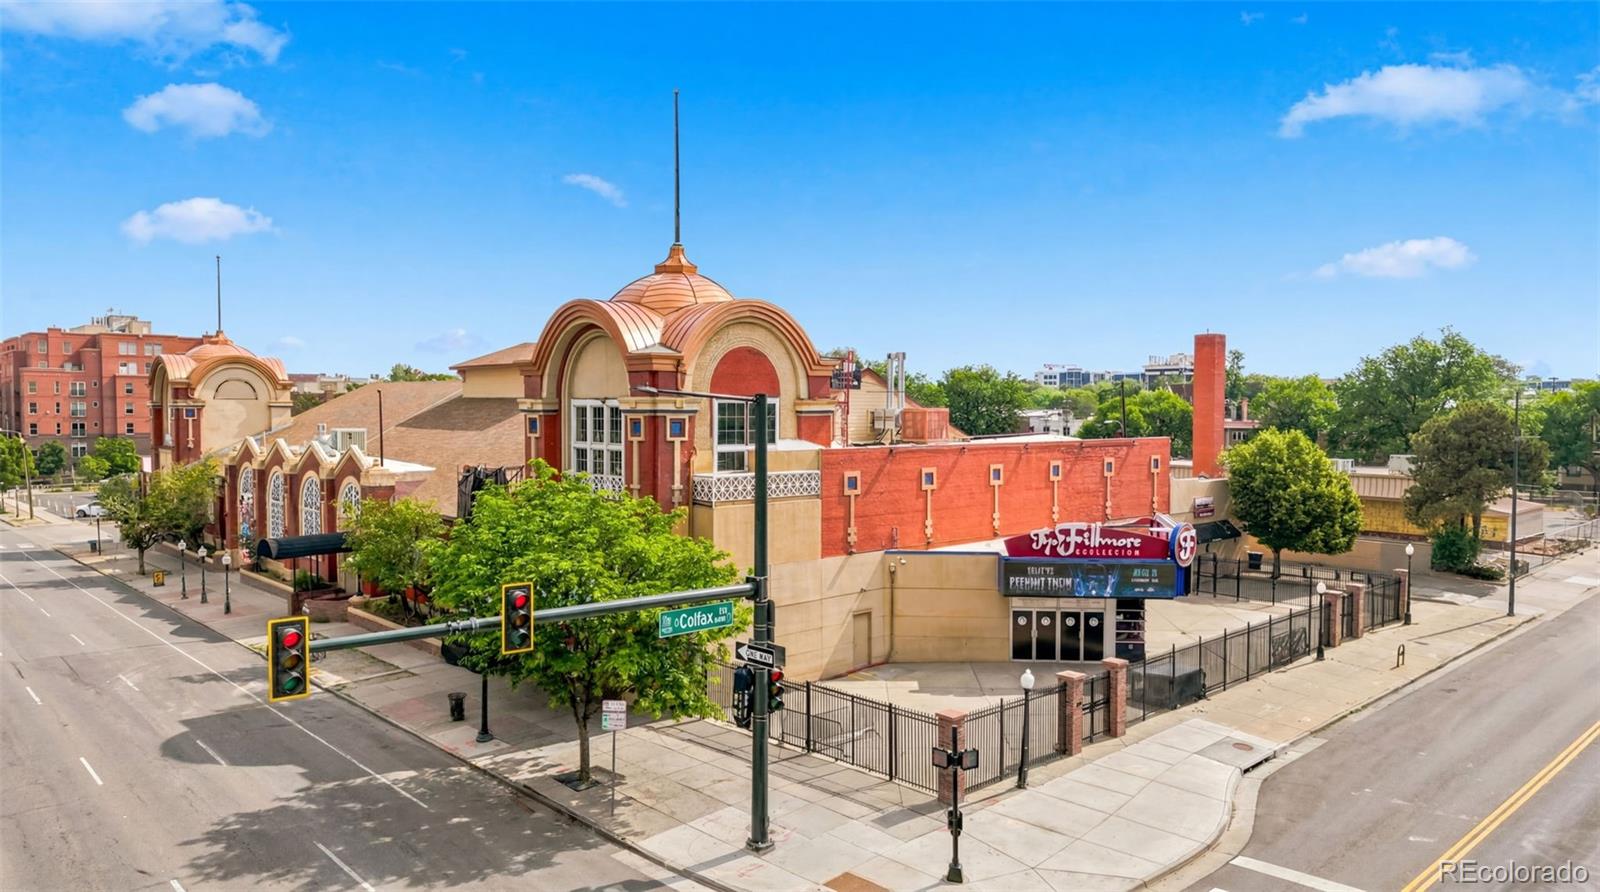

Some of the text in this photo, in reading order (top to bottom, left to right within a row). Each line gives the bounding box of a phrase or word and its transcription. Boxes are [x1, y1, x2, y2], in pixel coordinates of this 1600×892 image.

[1055, 522, 1141, 556] Fillmore
[680, 611, 713, 629] Colfax
[746, 649, 772, 662] ONE WAY
